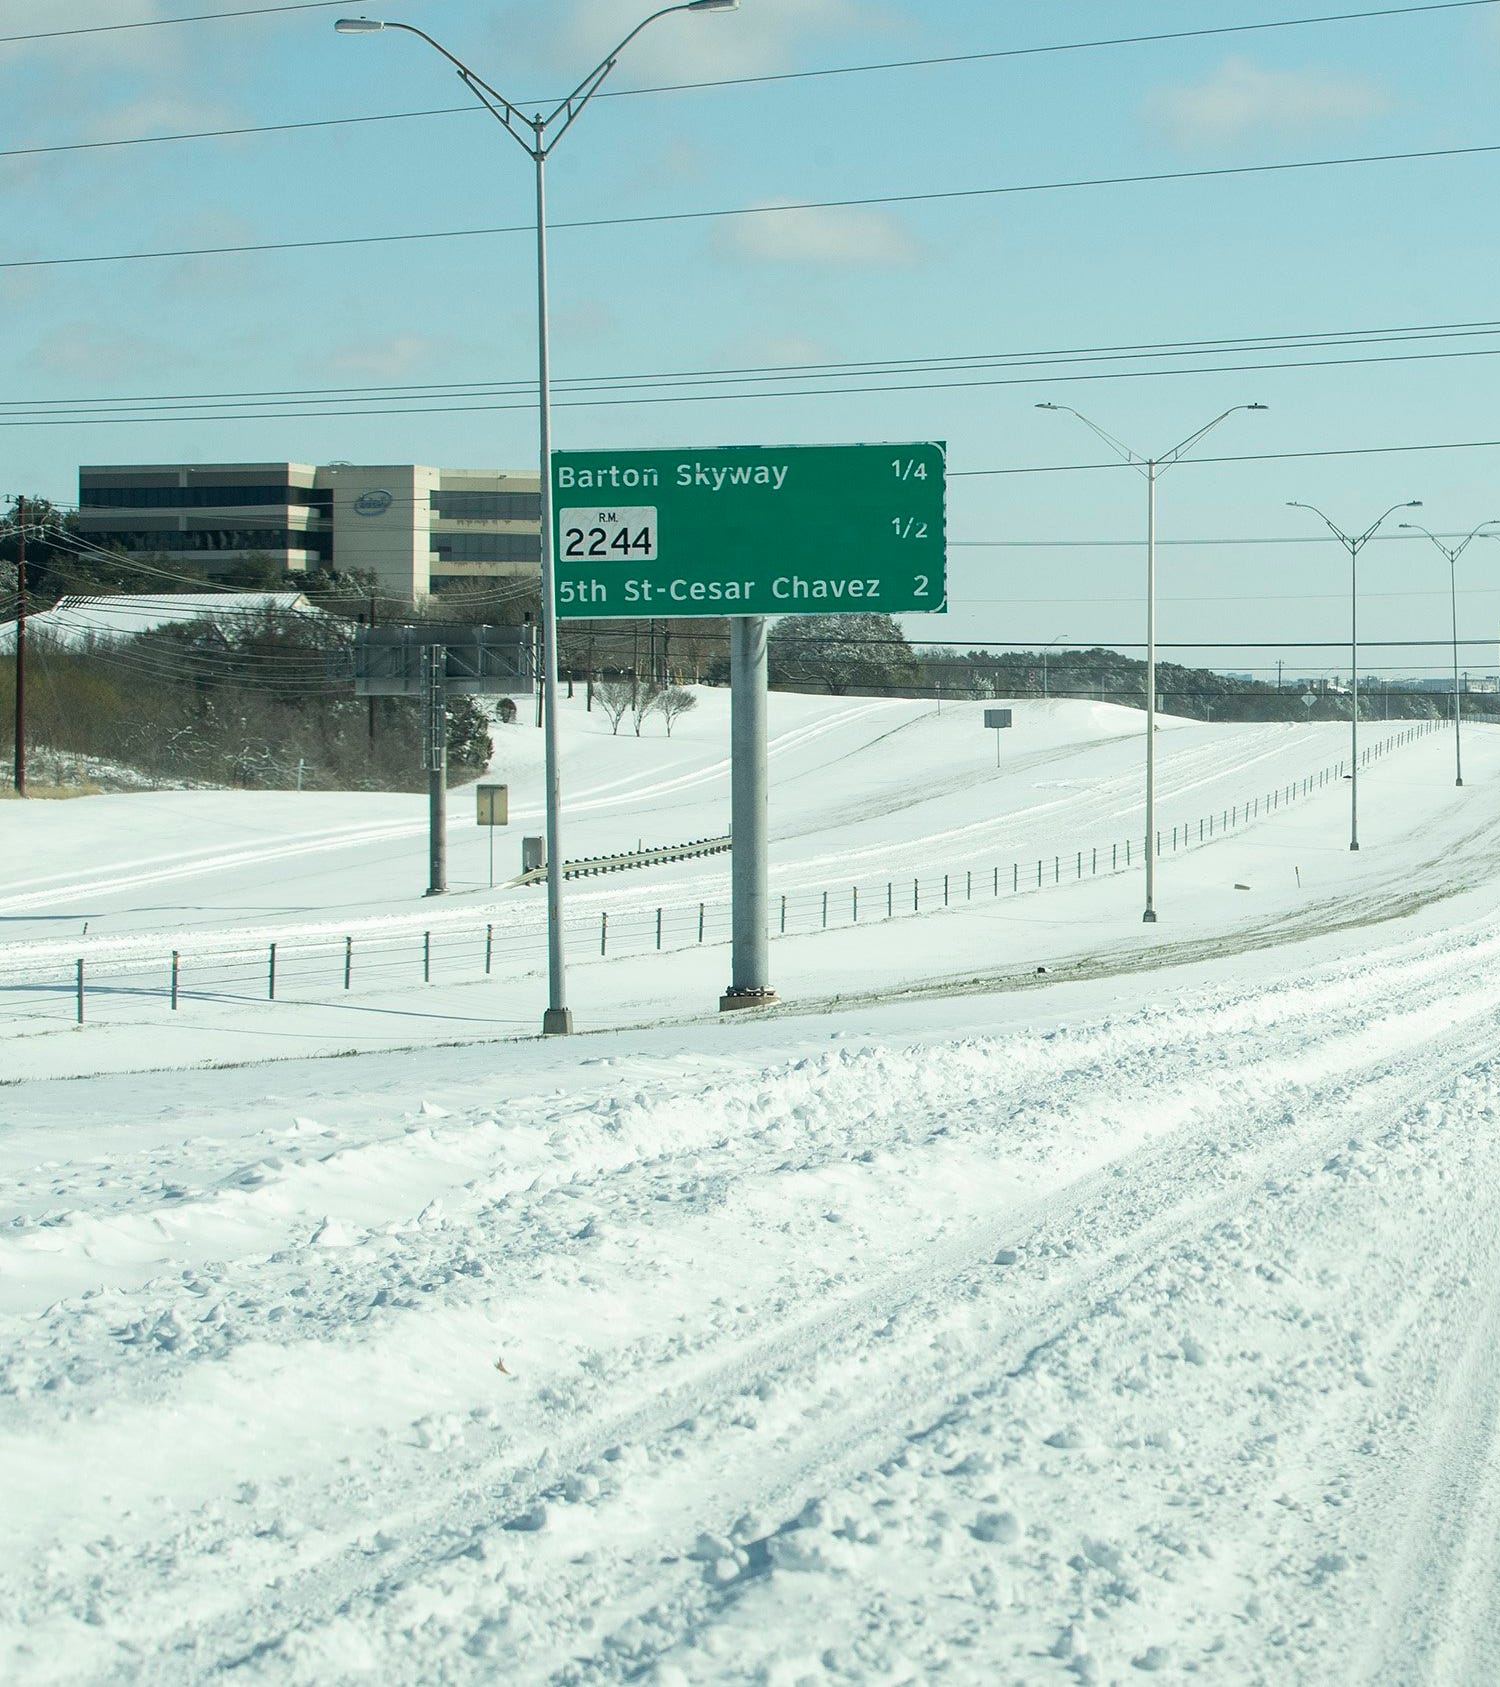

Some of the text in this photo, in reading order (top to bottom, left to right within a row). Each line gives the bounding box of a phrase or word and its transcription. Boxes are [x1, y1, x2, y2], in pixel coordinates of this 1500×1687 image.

[558, 459, 928, 491] Barton Skyway 1/4
[598, 512, 619, 523] R.M.
[565, 517, 928, 557] 2244 1/2
[559, 574, 929, 603] 5th St-Cesar Chavez 2
